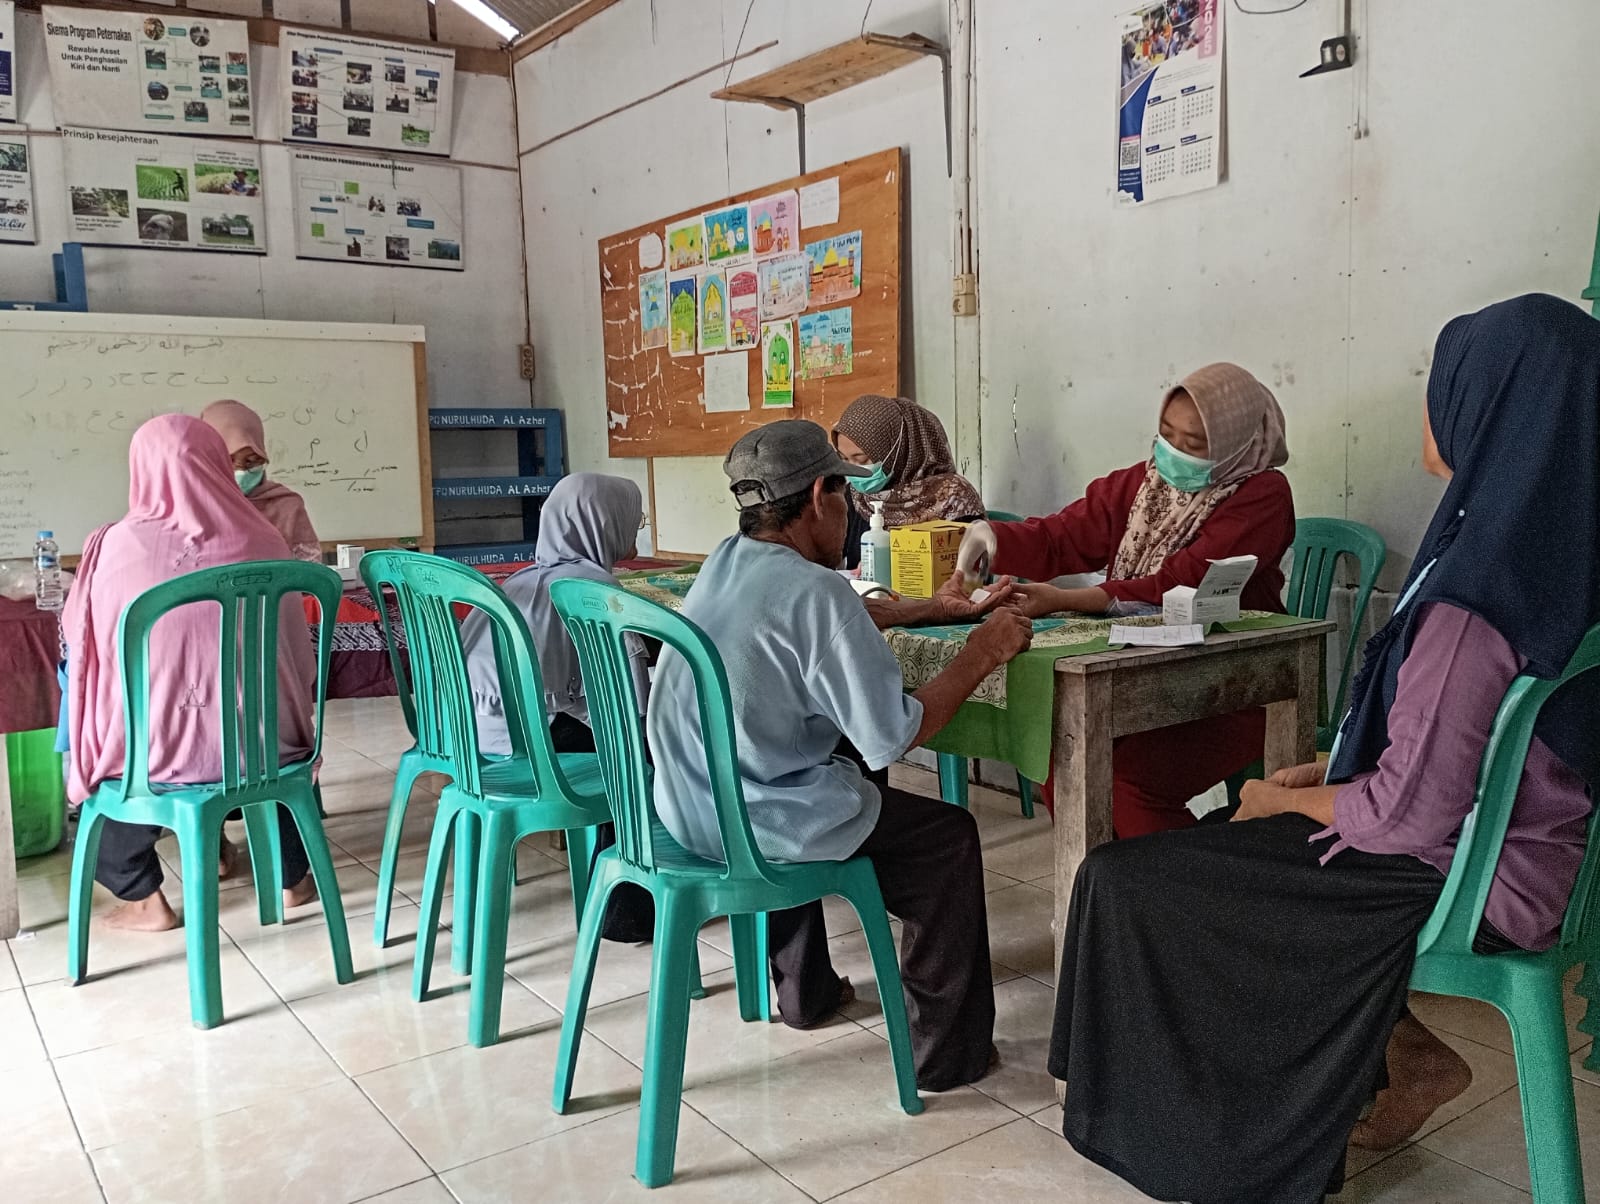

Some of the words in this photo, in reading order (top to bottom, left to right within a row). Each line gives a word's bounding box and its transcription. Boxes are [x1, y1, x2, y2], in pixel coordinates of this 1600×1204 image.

[46, 22, 69, 37] Skema
[69, 24, 97, 41] Program
[97, 26, 132, 42] Peternakan
[100, 47, 121, 56] Asset
[61, 52, 83, 62] Untuk
[84, 54, 128, 65] Penghasilan
[70, 62, 86, 71] Kini
[87, 63, 101, 72] dan
[102, 65, 121, 74] Nanti
[63, 129, 95, 141] Prinsip
[96, 131, 159, 145] kesejahteraan
[503, 415, 516, 425] AL
[507, 485, 520, 495] AL
[513, 552, 525, 562] AL
